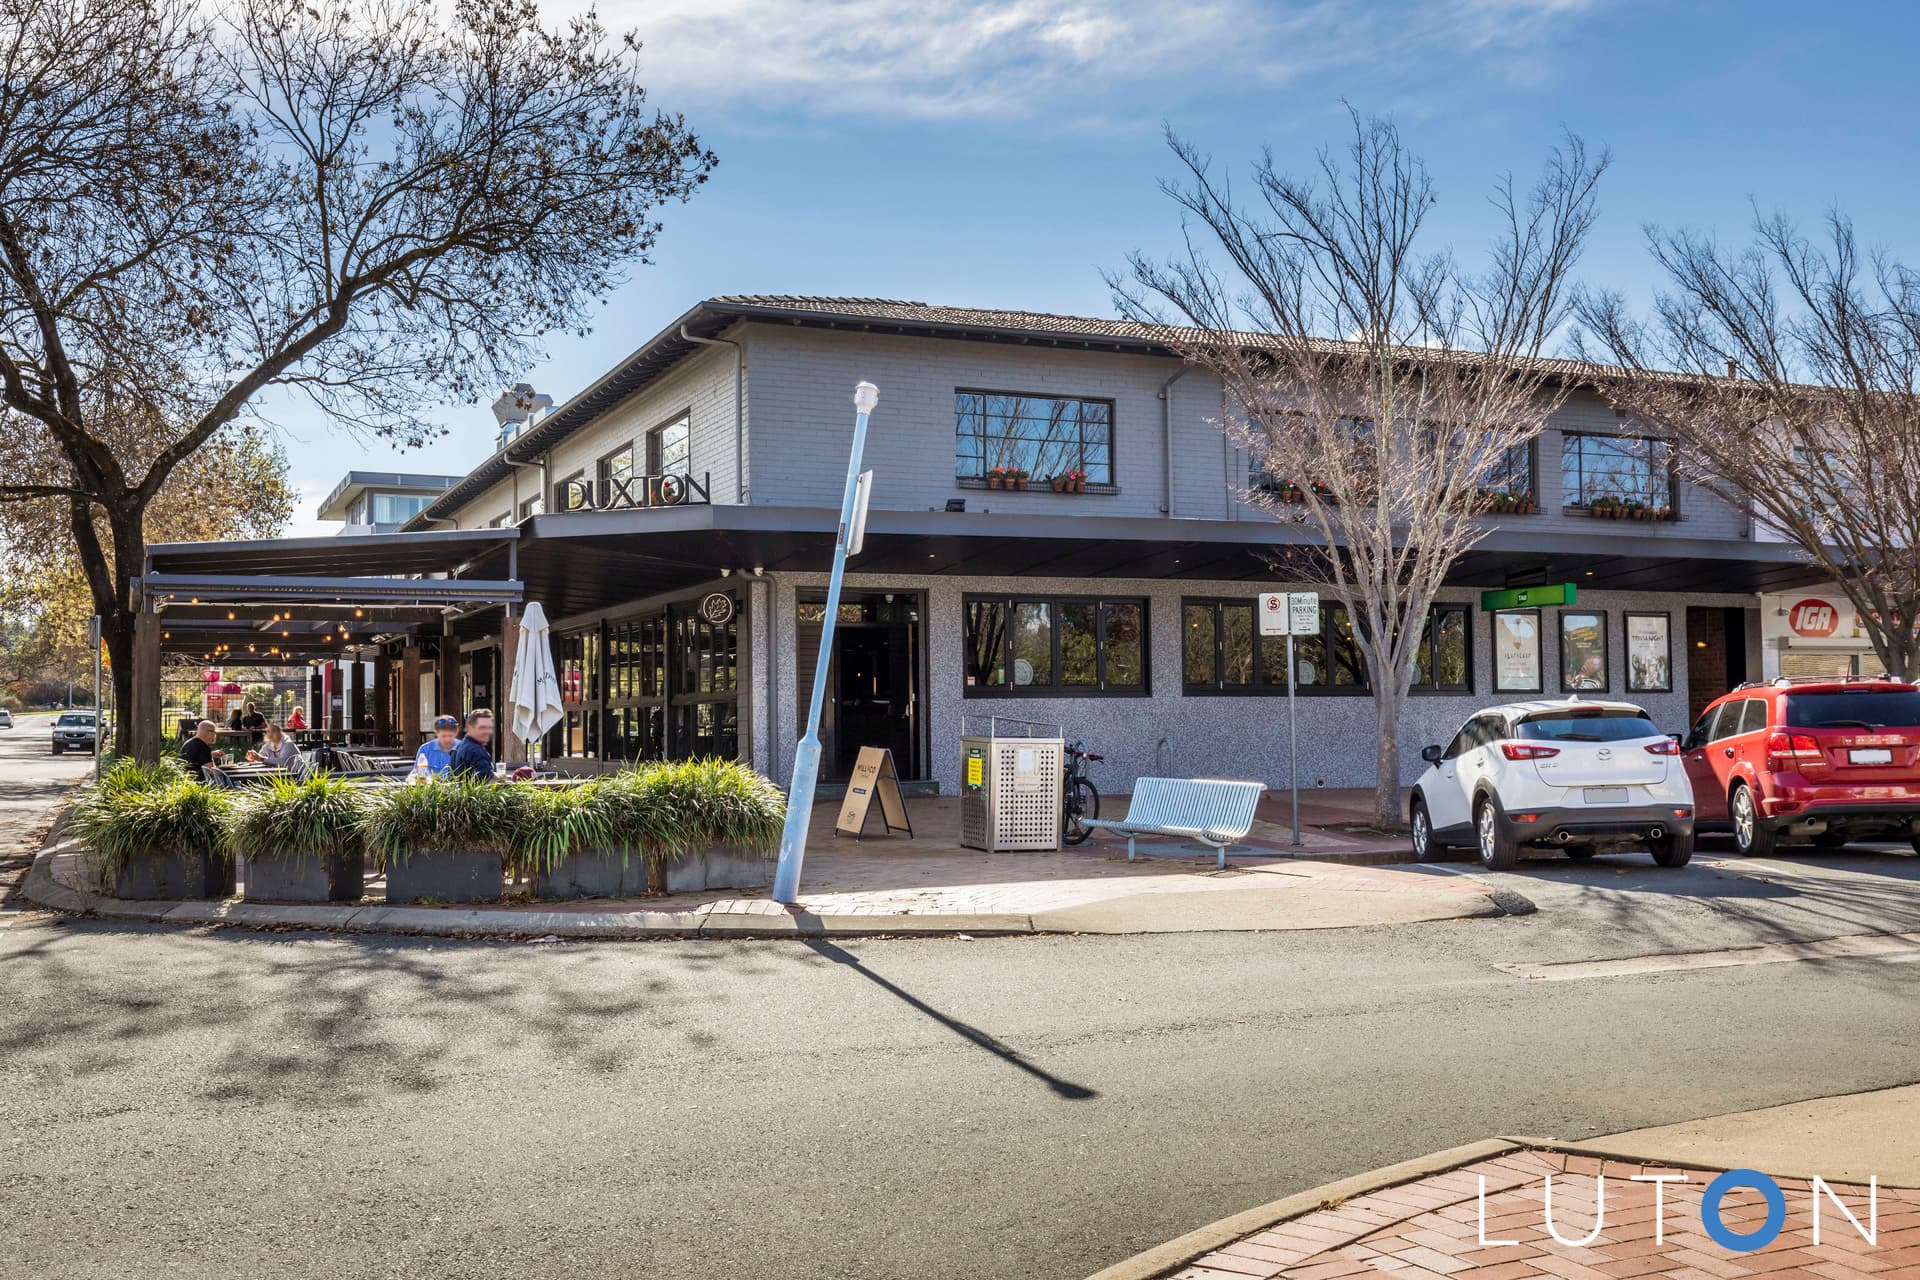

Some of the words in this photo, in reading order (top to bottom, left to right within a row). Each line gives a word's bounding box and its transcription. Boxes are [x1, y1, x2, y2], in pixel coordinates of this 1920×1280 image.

[562, 472, 711, 511] DUXTON
[1292, 606, 1317, 614] PARKING
[1794, 606, 1833, 630] IGA
